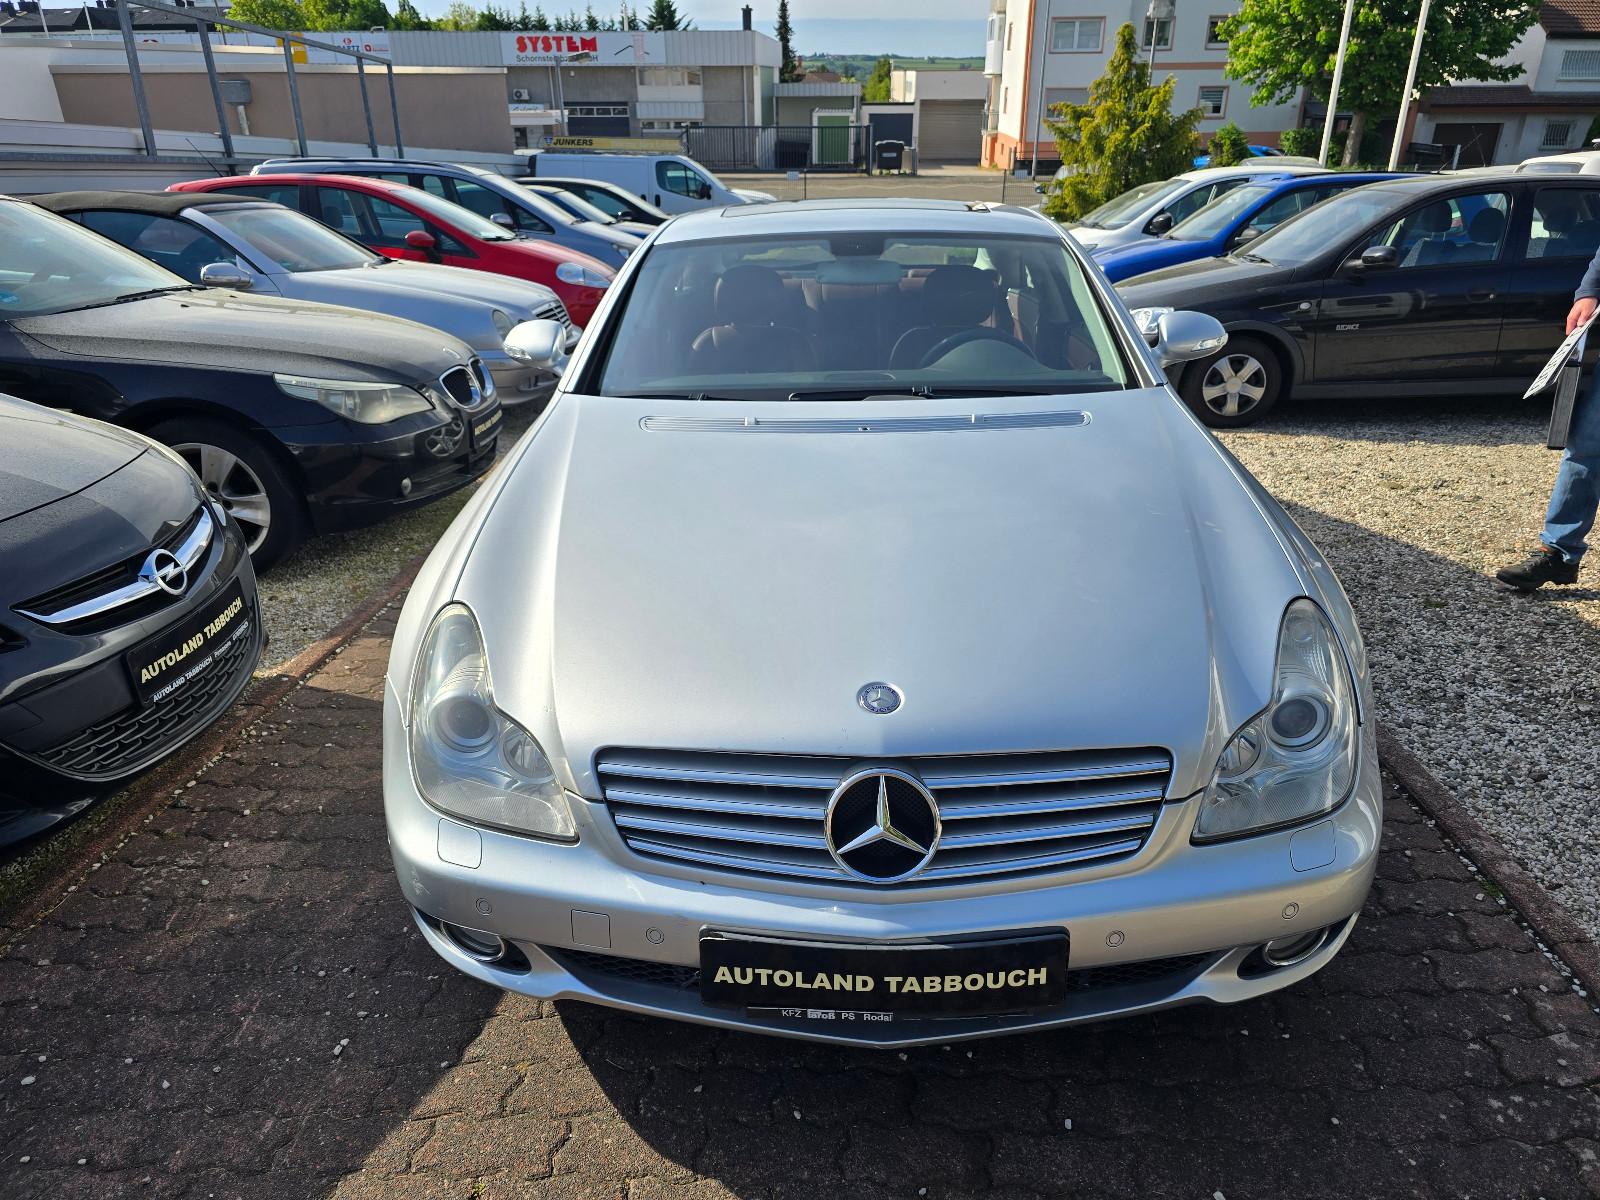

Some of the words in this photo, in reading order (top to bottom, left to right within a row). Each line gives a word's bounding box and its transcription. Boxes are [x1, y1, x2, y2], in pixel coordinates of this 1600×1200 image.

[516, 35, 597, 53] SYSTEM
[553, 138, 593, 146] JUNKERS
[141, 632, 204, 684] AUTOLAND
[203, 596, 243, 639] TABBOUCH
[153, 676, 186, 702] AUTOLAND
[185, 656, 213, 679] TABBOUCH
[713, 966, 875, 993] AUTOLAND
[883, 967, 1048, 993] TABBOUCH
[781, 1009, 802, 1018] KFZ
[841, 1012, 856, 1020] PS
